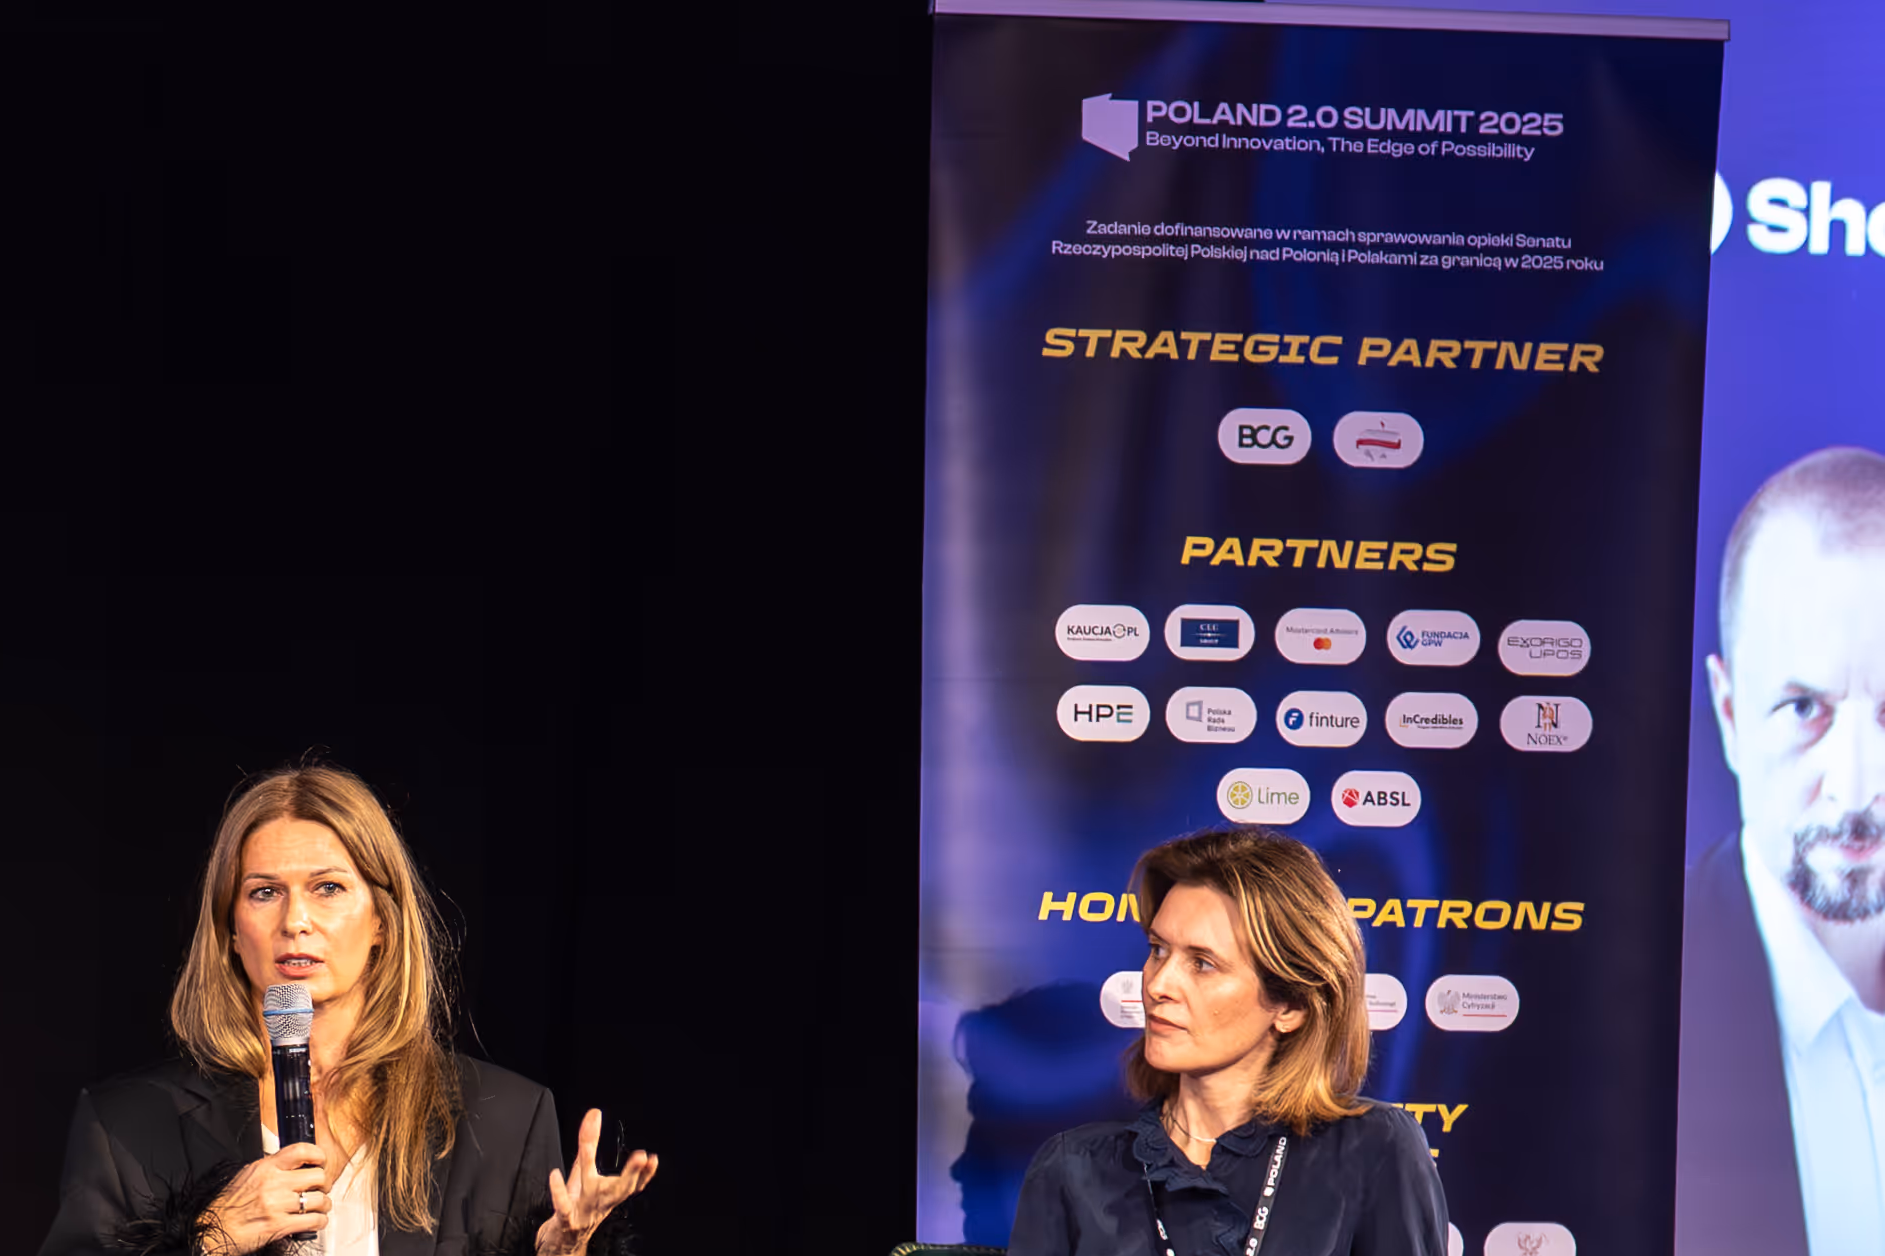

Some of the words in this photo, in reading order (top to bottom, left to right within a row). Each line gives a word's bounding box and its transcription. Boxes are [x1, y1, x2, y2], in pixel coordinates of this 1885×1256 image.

[1146, 100, 1282, 127] POLAND
[1287, 104, 1339, 129] 2.0
[1343, 106, 1475, 133] SUMMIT
[1479, 111, 1564, 136] 2025
[1146, 131, 1219, 150] Beyond
[1222, 135, 1325, 153] Innovation,
[1327, 136, 1364, 152] The
[1367, 138, 1415, 158] Edge
[1418, 140, 1439, 156] of
[1441, 140, 1535, 162] Possibility
[1086, 220, 1151, 236] Zadanie
[1153, 222, 1272, 239] dofinansowane
[1276, 229, 1290, 240] w
[1293, 228, 1355, 242] ramach
[1357, 231, 1465, 247] sprawowania
[1467, 232, 1513, 249] opieki
[1516, 233, 1571, 249] Senatu
[1052, 240, 1188, 260] Rzeczypospolitej
[1191, 243, 1247, 262] Polskiej
[1250, 245, 1280, 261] nad
[1348, 249, 1417, 265] Polakami
[1419, 254, 1439, 265] za
[1504, 257, 1518, 268] w
[1521, 254, 1564, 269] 2025
[1566, 256, 1604, 271] roku
[1041, 327, 1343, 365] STRATEGIC
[1357, 336, 1605, 373] PARTNER
[1237, 424, 1295, 450] BCG
[1180, 536, 1458, 573] PARTNERS
[1421, 630, 1469, 640] FUNDACJA
[1507, 637, 1583, 648] EXORIGO
[1529, 649, 1582, 660] UPOS
[1074, 703, 1133, 723] HPE
[1309, 712, 1360, 729] finture
[1402, 714, 1464, 725] InCredibles
[1362, 790, 1411, 807] ABSL
[1347, 897, 1585, 932] PATRONS
[1254, 1206, 1269, 1230] BCG
[1267, 1136, 1287, 1187] POLAND
